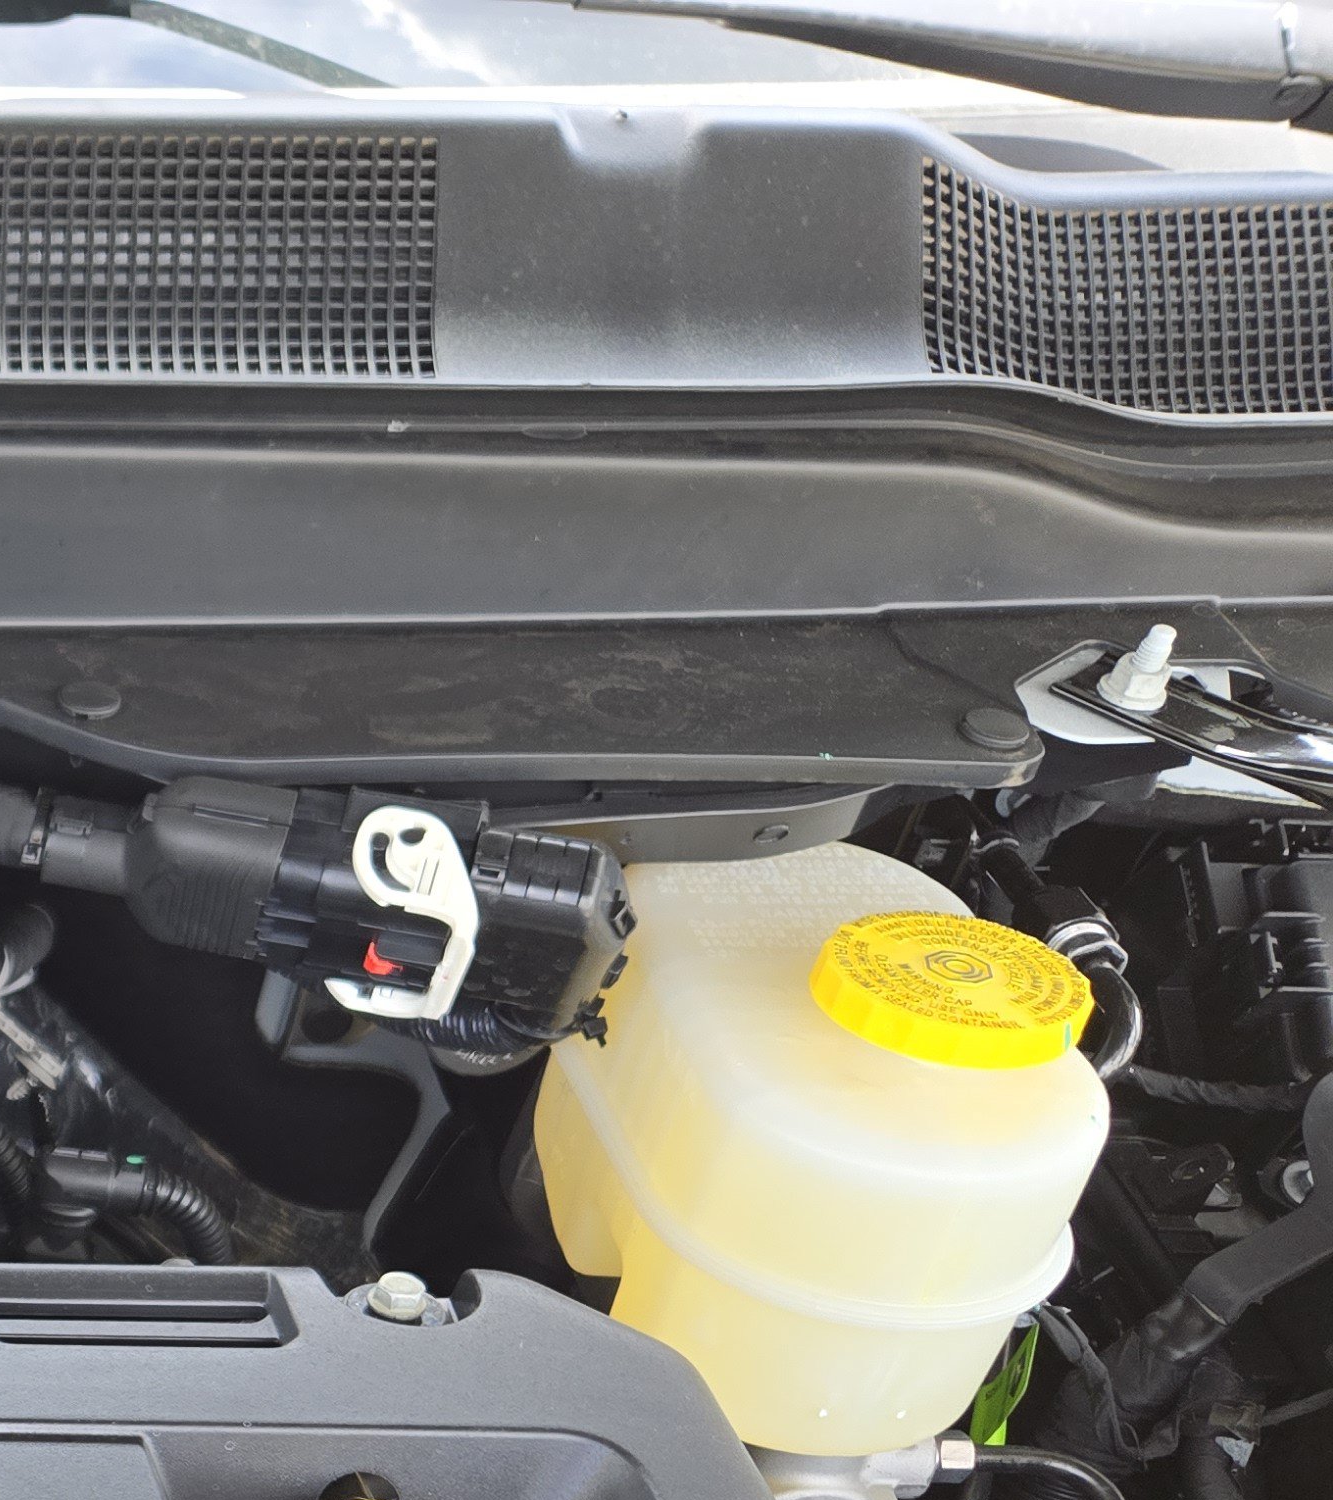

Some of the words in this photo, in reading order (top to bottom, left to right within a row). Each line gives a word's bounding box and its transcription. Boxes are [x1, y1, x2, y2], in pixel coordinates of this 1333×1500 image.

[905, 928, 961, 937] LIQUIDE
[968, 933, 998, 946] DOT
[915, 936, 1011, 961] CONTENANT
[879, 994, 935, 1017] SEALED
[942, 995, 974, 1007] CAP
[963, 1009, 1002, 1018] ONLY
